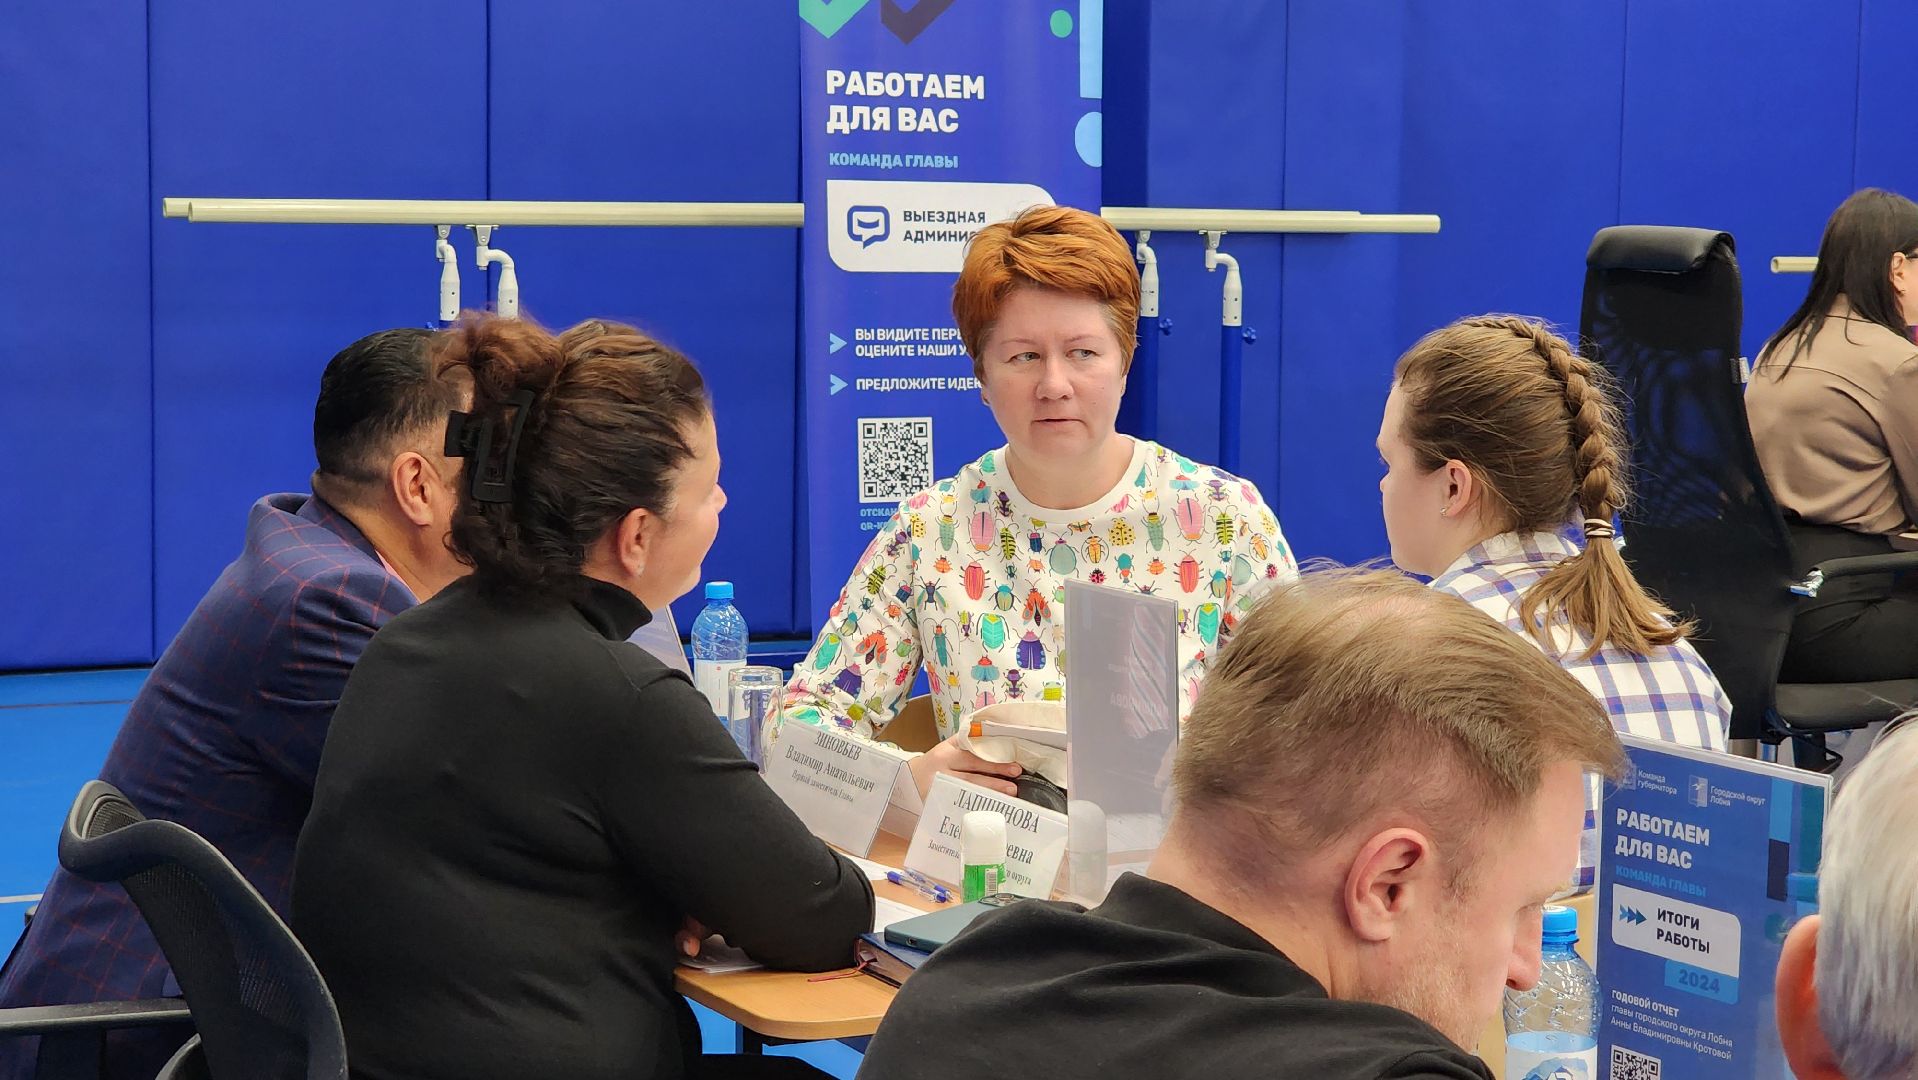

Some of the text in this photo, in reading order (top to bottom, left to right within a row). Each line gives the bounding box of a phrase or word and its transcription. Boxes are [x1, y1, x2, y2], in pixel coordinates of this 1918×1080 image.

[826, 70, 985, 100] РАБОТАЕМ
[826, 105, 959, 135] ДЛЯ ВАС
[829, 152, 958, 169] КОМАНДА ГЛАВЫ
[903, 210, 986, 225] ВЫЕЗДНАЯ
[855, 328, 875, 341] ВЫ
[877, 328, 929, 342] ВИДИТЕ
[855, 345, 915, 359] ОЦЕНИТЕ
[918, 344, 957, 356] НАШИ
[856, 378, 946, 392] ПРЕДЛОЖИТЕ
[814, 731, 862, 760] ЗИНОВЬЕВ
[785, 744, 875, 793] Владимир Анатольевич
[1638, 770, 1666, 784] Команда
[1637, 780, 1678, 795] губернатора
[1710, 785, 1766, 805] Городской округ
[1616, 808, 1710, 846] РАБОТАЕМ
[1615, 835, 1693, 869] ДЛЯ ВАС
[1615, 865, 1707, 898] КОМАНДА ГЛАВЫ
[1657, 907, 1700, 931] ИТОГИ
[1656, 928, 1710, 954] РАБОТЫ
[1678, 968, 1720, 994] 2024
[1611, 989, 1679, 1018] ГОДОВОЙ ОТЧЕТ
[1611, 1005, 1733, 1048] главы городского округа Лобня
[1611, 1016, 1732, 1061] Анны Владимировны Кротовой
